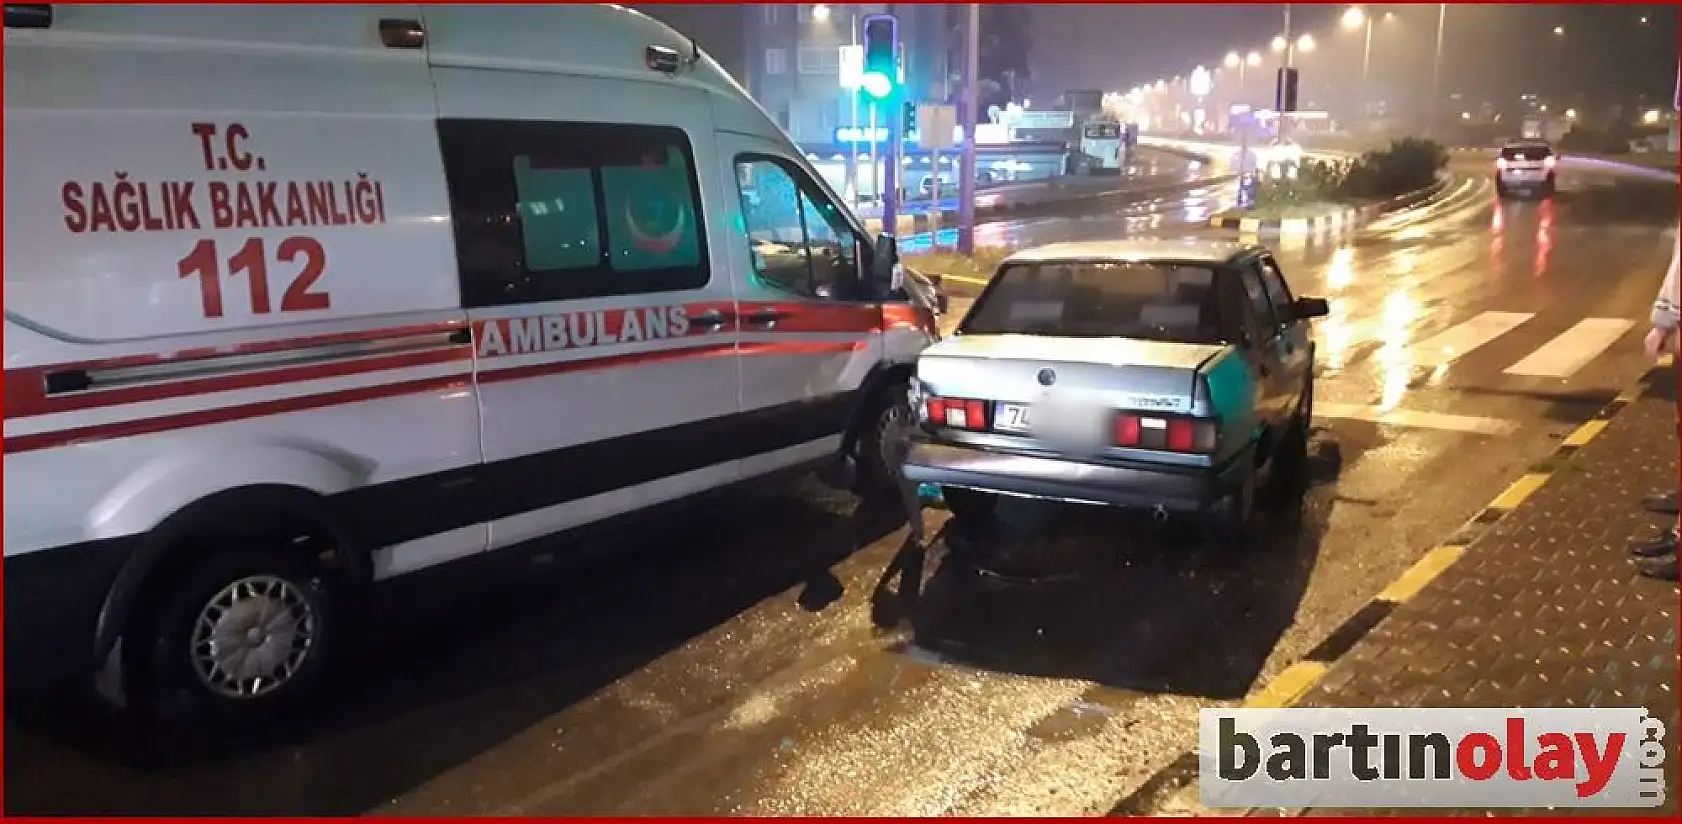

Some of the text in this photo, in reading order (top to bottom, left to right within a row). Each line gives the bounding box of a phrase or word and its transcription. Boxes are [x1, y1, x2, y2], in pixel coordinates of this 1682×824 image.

[192, 123, 265, 171] T.C.
[62, 171, 386, 233] SAĞLIK BAKANLIĞI
[178, 236, 330, 319] 112
[480, 305, 690, 357] AMBULANS
